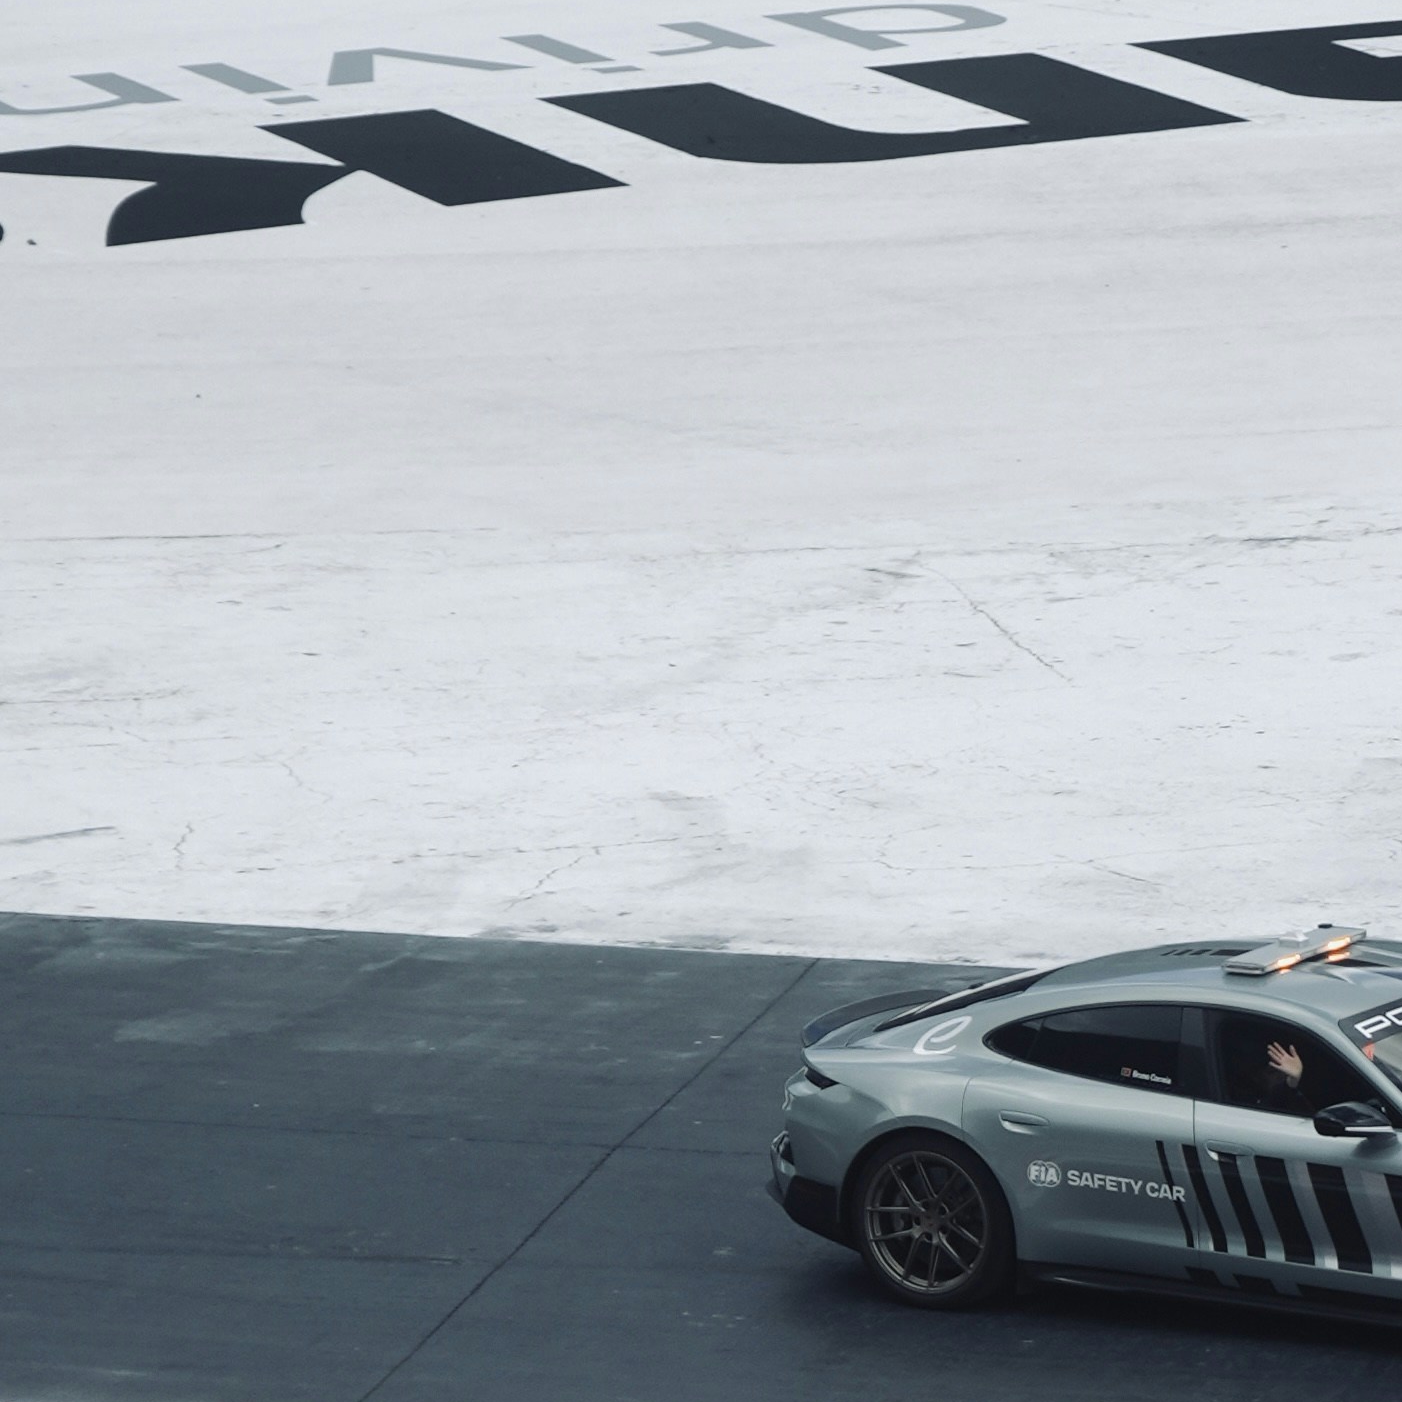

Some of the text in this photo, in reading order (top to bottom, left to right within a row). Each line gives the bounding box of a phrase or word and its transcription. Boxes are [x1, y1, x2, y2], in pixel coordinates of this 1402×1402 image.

[1028, 1163, 1185, 1203] FIA SAFETY CAR
